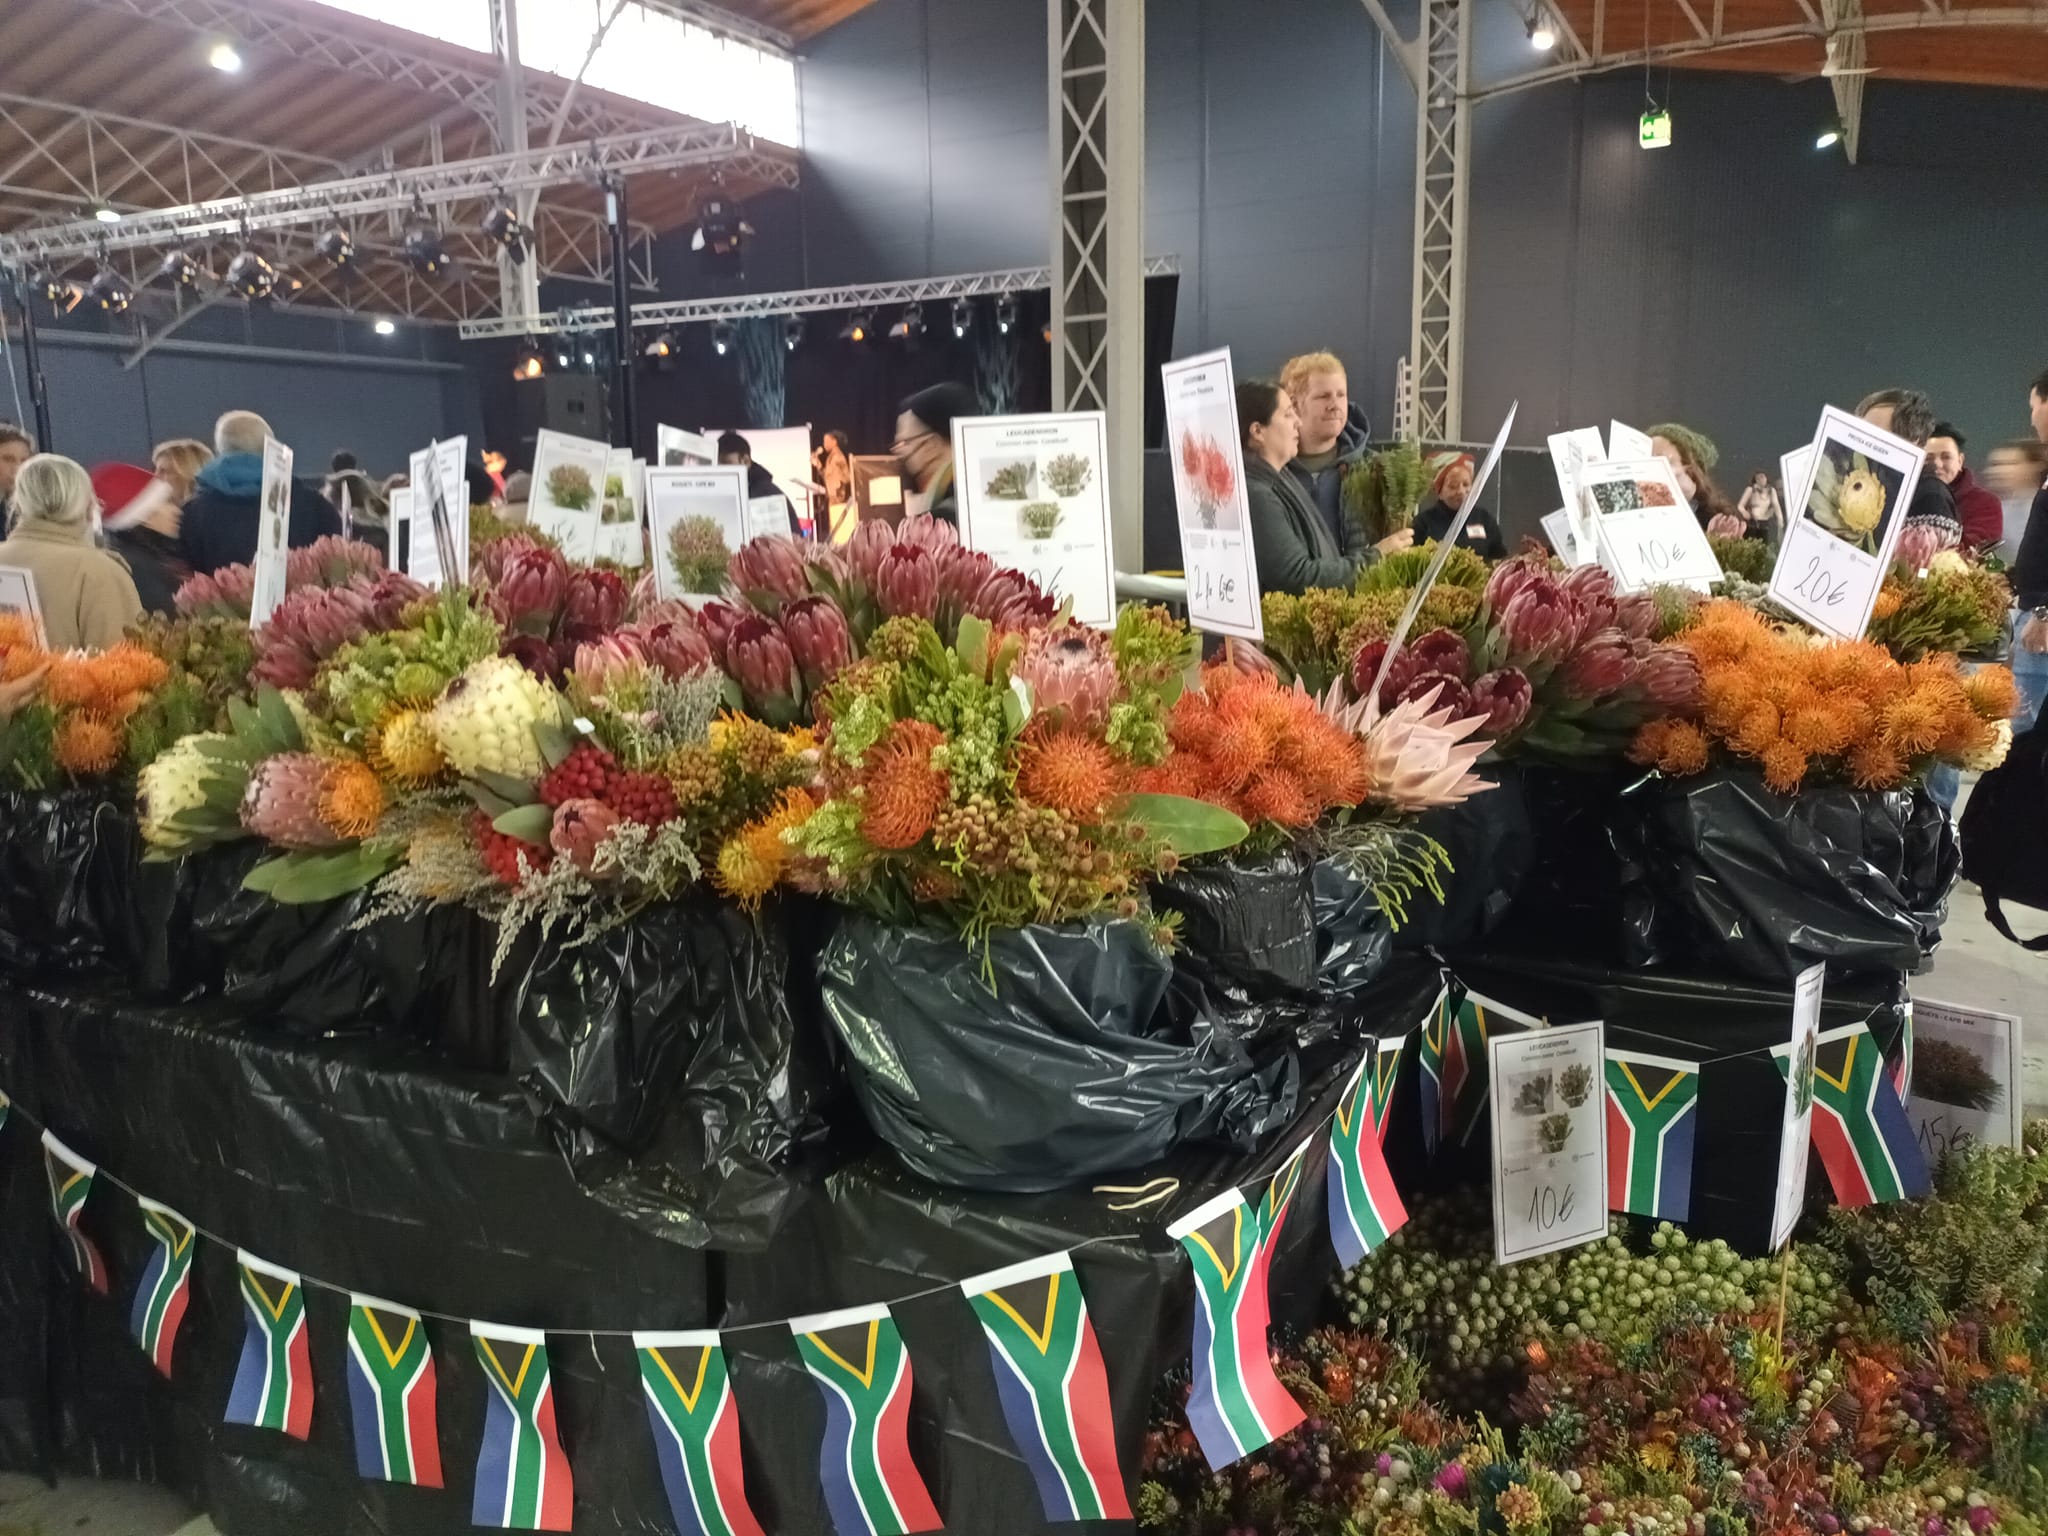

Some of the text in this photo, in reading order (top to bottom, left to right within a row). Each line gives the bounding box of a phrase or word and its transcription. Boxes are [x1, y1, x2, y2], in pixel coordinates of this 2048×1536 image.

[1637, 539, 1686, 574] 10€
[1793, 555, 1849, 606] 20€
[1528, 1183, 1576, 1233] 10€
